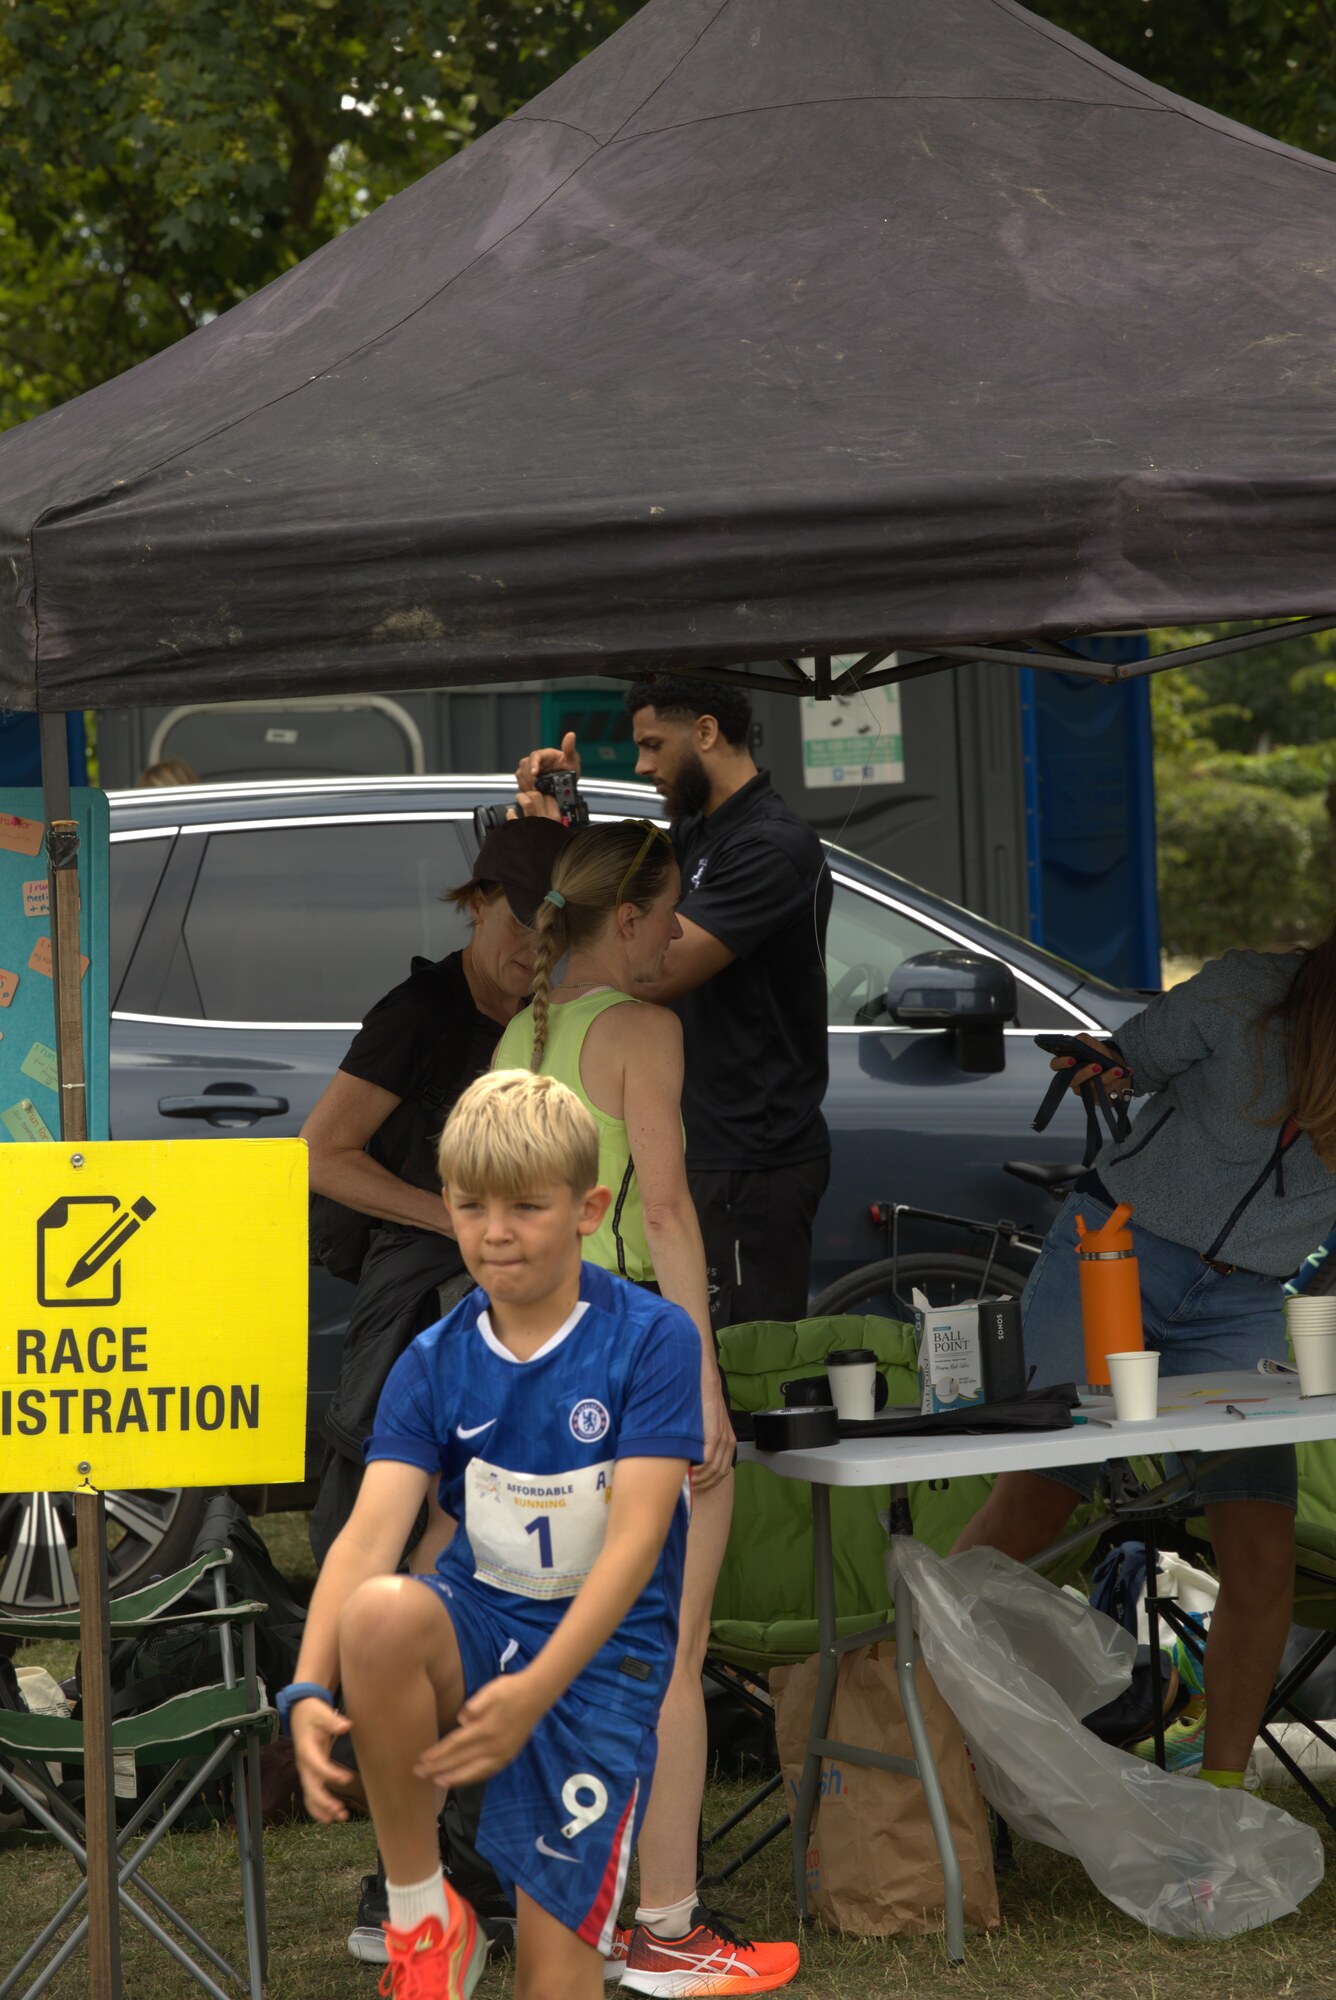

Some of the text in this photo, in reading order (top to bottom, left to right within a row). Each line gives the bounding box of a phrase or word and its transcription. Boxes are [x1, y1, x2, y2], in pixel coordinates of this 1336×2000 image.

[17, 1327, 148, 1374] RACE
[934, 1331, 965, 1342] BALL
[934, 1340, 970, 1352] POINT
[2, 1384, 260, 1436] ISTRATION
[506, 1482, 574, 1497] AFFORDABLE
[513, 1496, 567, 1510] RUNNING
[524, 1515, 554, 1568] 1
[560, 1772, 609, 1840] 9
